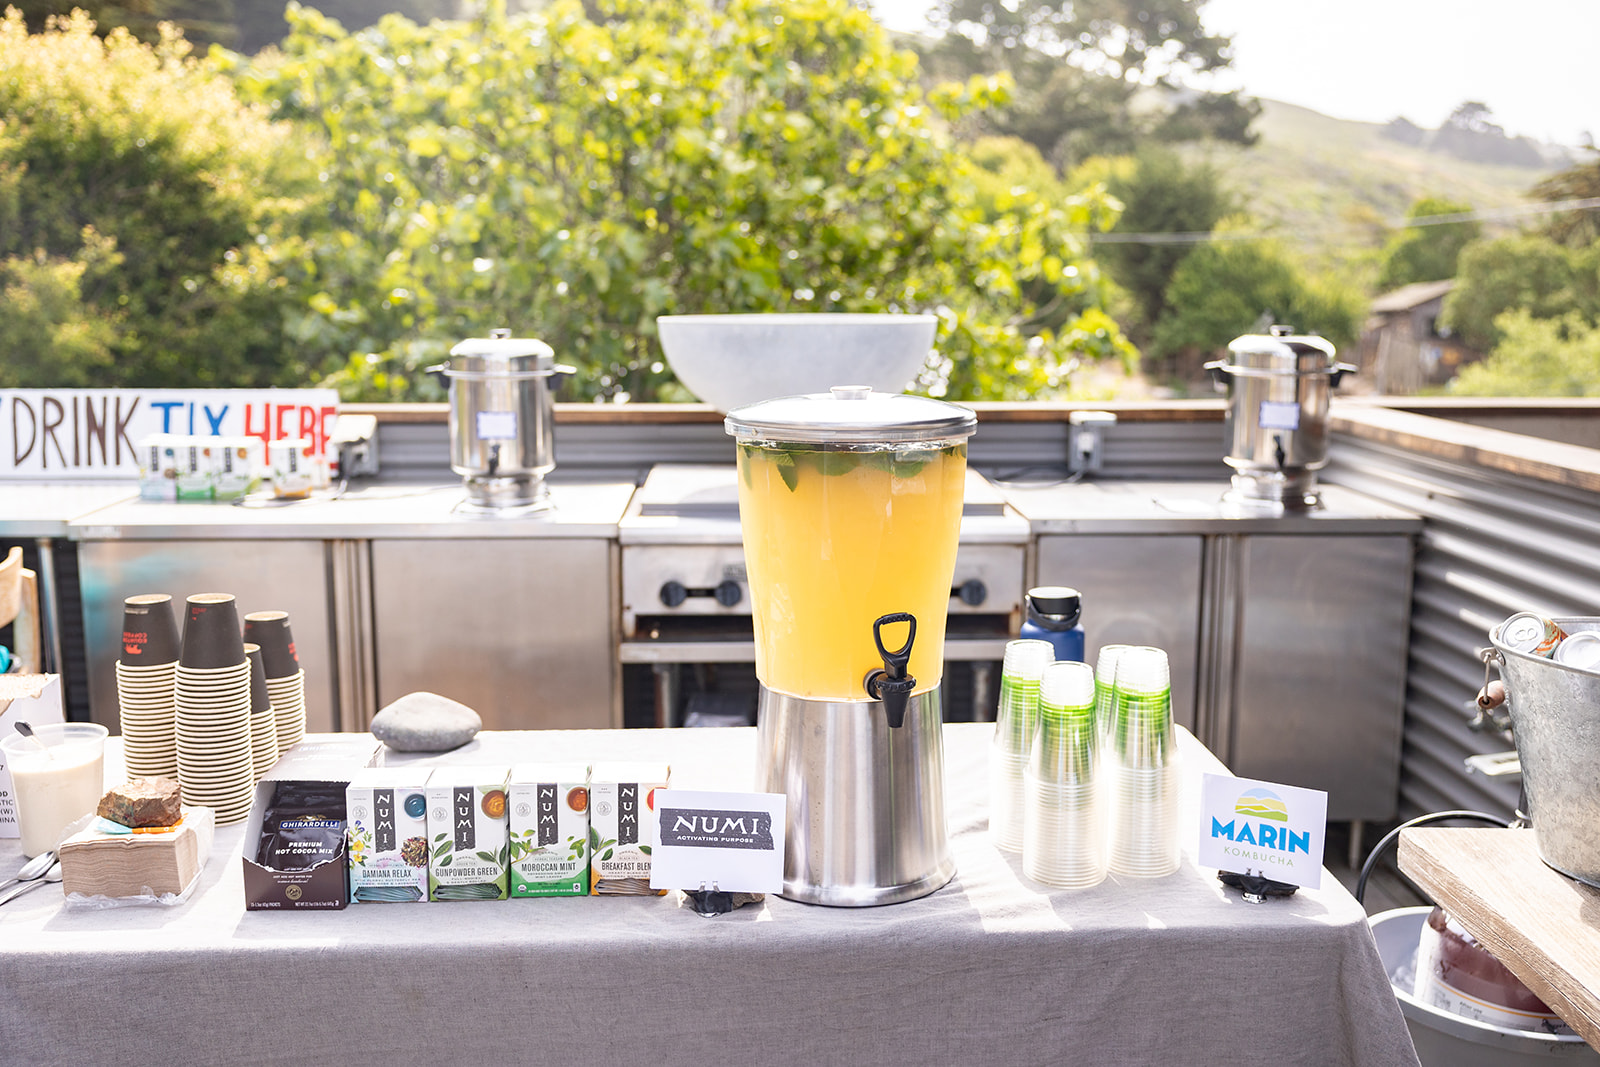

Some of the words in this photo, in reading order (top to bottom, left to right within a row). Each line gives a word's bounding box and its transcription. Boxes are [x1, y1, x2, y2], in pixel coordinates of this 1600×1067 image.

[12, 395, 141, 469] DRINK
[376, 794, 393, 844] NUMI
[456, 792, 473, 843] NUMI
[540, 788, 556, 838] NUMI
[620, 787, 636, 837] NUMI
[281, 821, 338, 829] GHIRARDELLI
[672, 815, 760, 835] NUMI
[1211, 815, 1310, 855] MARIN
[521, 863, 558, 872] MOROCCAN
[559, 862, 576, 871] MINT
[601, 862, 635, 871] BREAKFAST
[636, 862, 652, 871] BLEN
[1223, 845, 1295, 867] KOMBUCHA
[362, 869, 392, 879] DAMIANA
[392, 869, 412, 878] RELAX
[435, 867, 476, 877] GUNPOWDER
[477, 866, 498, 876] GREEN
